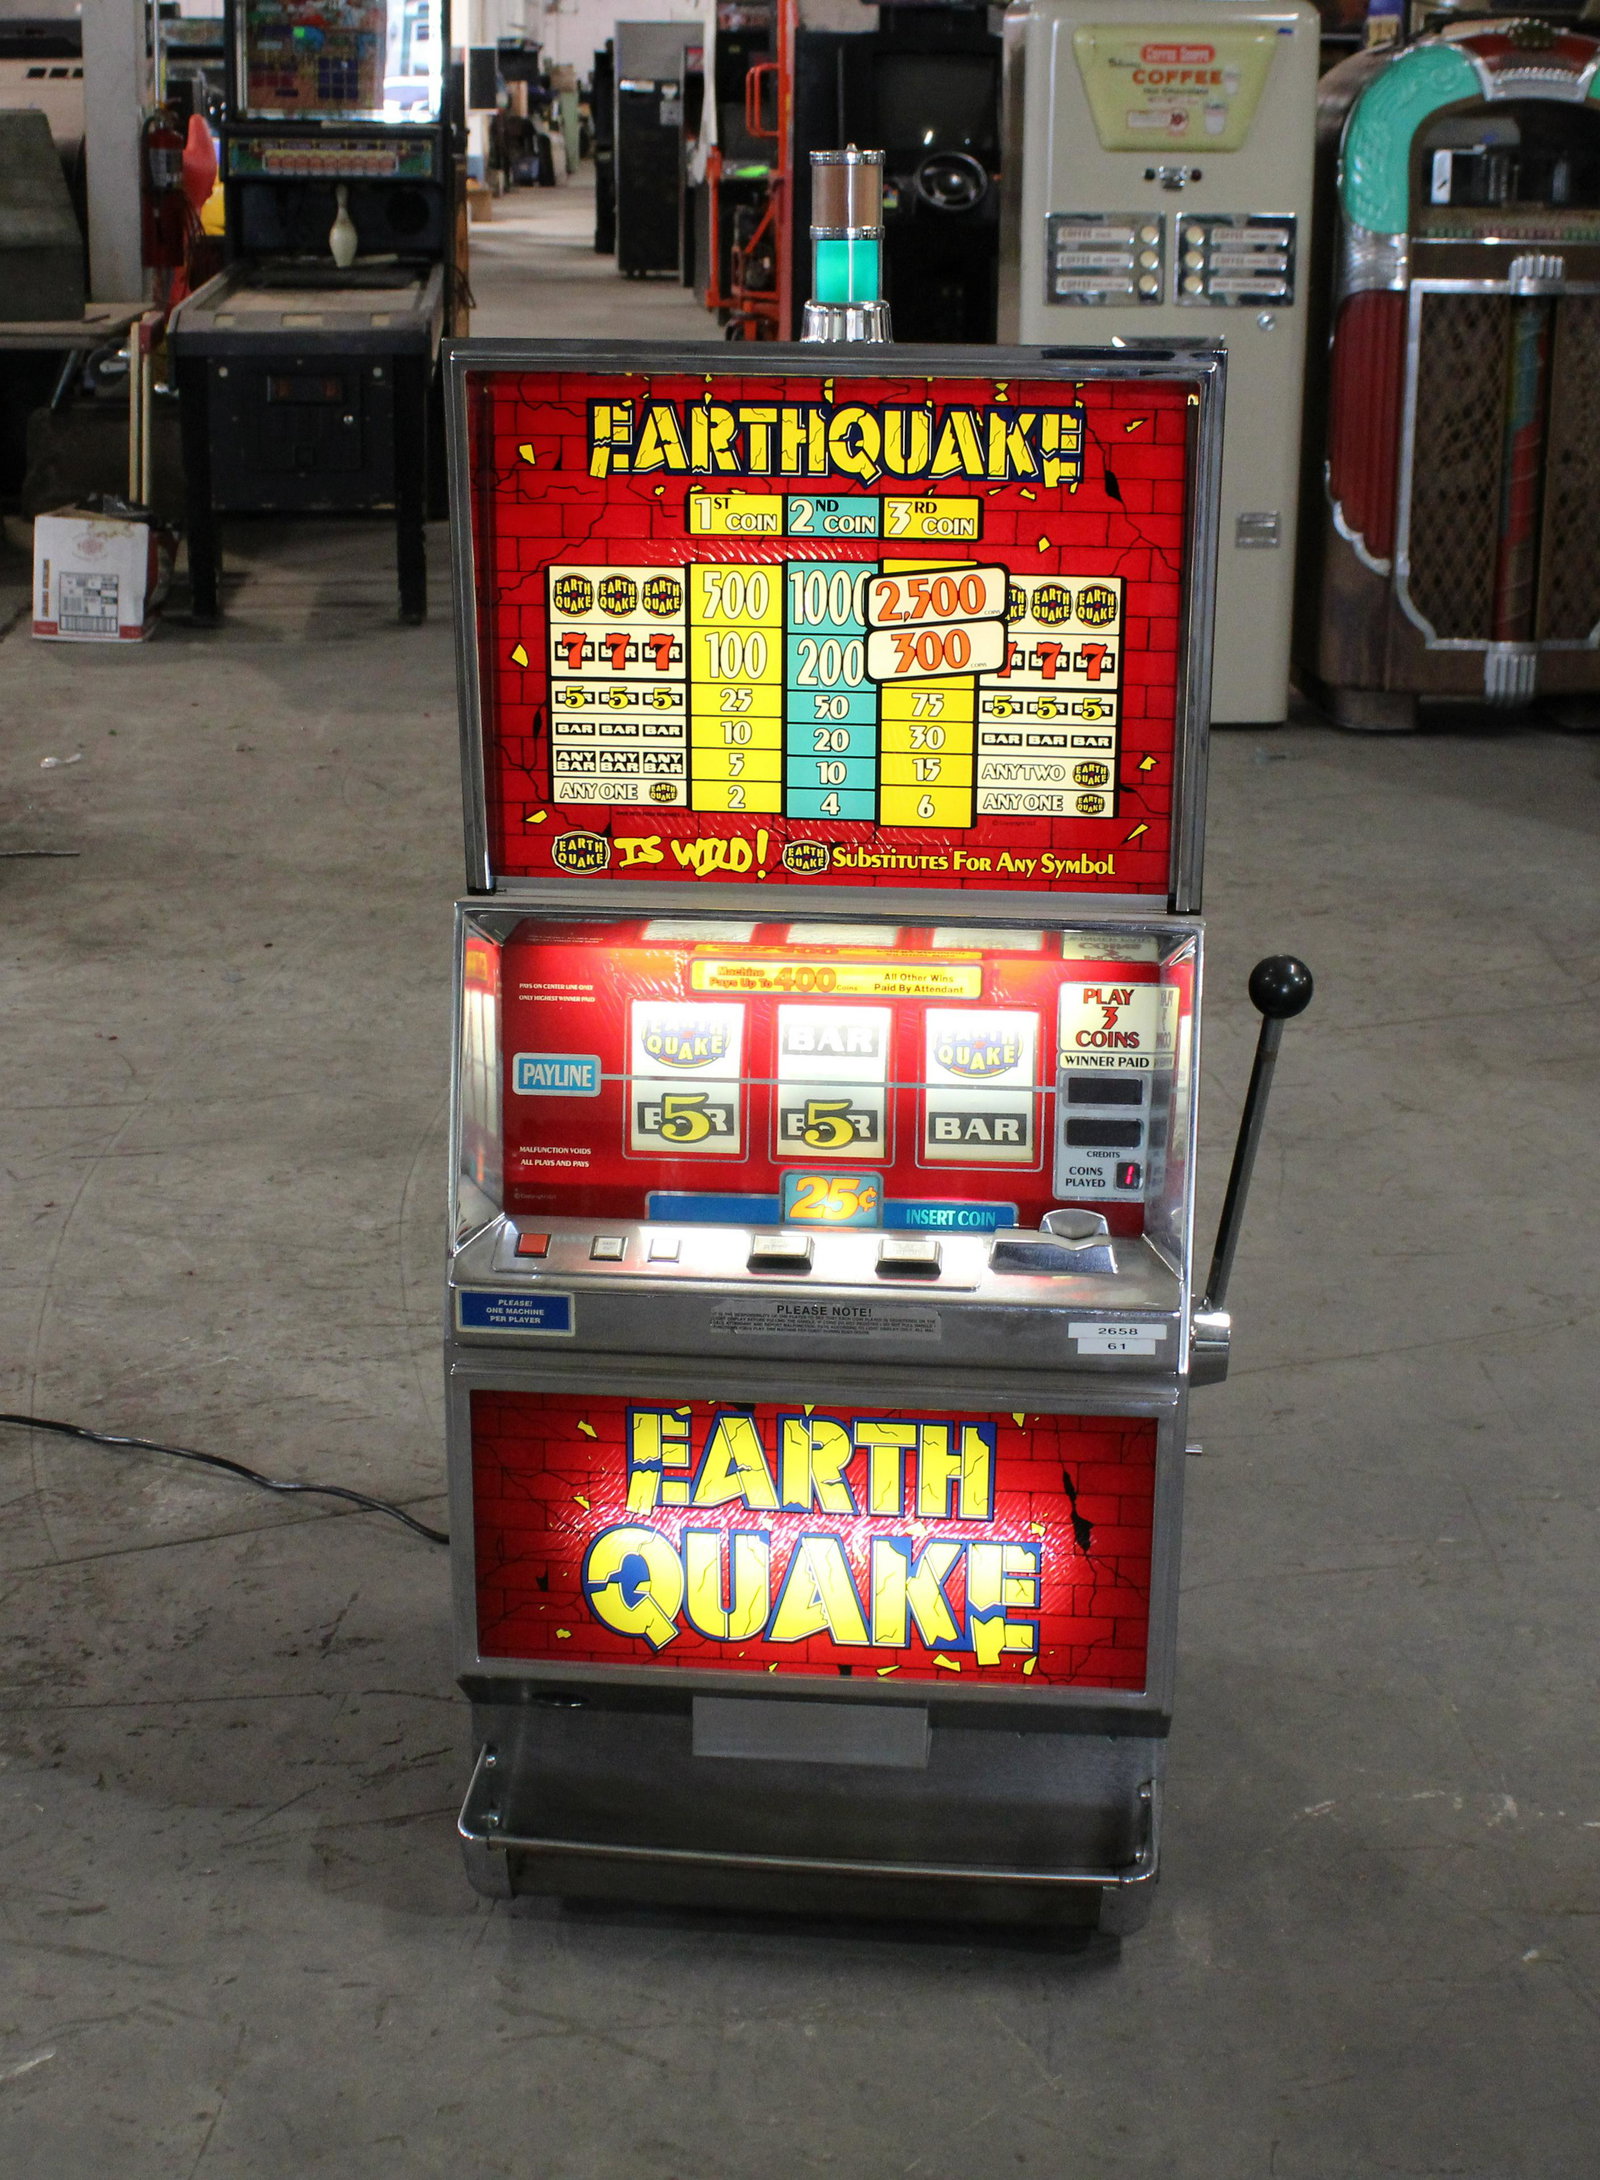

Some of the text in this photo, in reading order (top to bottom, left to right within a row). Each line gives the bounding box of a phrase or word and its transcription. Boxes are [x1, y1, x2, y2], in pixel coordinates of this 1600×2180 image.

[1132, 69, 1223, 85] COFFEE
[589, 402, 1083, 488] EARTHQUAKE
[725, 513, 777, 532] COIN
[822, 515, 876, 534] COIN
[921, 517, 975, 536] COIN
[556, 579, 591, 595] EARTH
[601, 580, 635, 596] EARTH
[644, 580, 680, 596] EARTH
[703, 570, 770, 620] 500
[555, 595, 591, 612] QUAKE
[600, 596, 635, 613] QUAKE
[644, 597, 680, 613] QUAKE
[789, 569, 872, 627] 1000
[875, 573, 987, 622] 2,500
[1034, 588, 1070, 605] EARTH
[1079, 589, 1115, 606] EARTH
[1033, 605, 1070, 622] QUAKE
[1077, 606, 1115, 623] QUAKE
[705, 631, 768, 679] 100
[891, 628, 972, 673] 300
[796, 638, 865, 688] 200
[720, 688, 753, 712] 25
[814, 695, 850, 719] 50
[911, 693, 945, 717] 75
[557, 724, 681, 736] BAR BAR BAR
[720, 720, 752, 745] 10
[909, 725, 946, 750] 30
[813, 728, 850, 752] 20
[984, 734, 1110, 747] BAR BAR BAR
[557, 751, 682, 763] ANY ANY ANY
[728, 753, 744, 776] 5
[557, 761, 682, 773] BAR BAR BAR
[816, 761, 847, 785] 10
[912, 757, 942, 781] 15
[981, 763, 1066, 781] ANY TWO
[1076, 764, 1107, 774] EARTH
[1074, 774, 1108, 785] QUAKE
[560, 782, 638, 800] ANY ONE
[728, 785, 746, 808] 2
[820, 792, 841, 815] 4
[917, 794, 935, 818] 6
[983, 793, 1064, 811] ANY ONE
[559, 840, 603, 853] EARTH
[613, 828, 769, 879] IS WILD!
[788, 844, 824, 857] EARTH
[557, 853, 604, 868] QUAKE
[787, 856, 824, 870] QUAKE
[709, 966, 858, 993] Pays Up To 400 Coins
[717, 966, 765, 978] Machine
[884, 972, 954, 983] All Other Wins
[874, 983, 964, 994] Paid By Attendant
[1083, 988, 1135, 1005] PLAY
[1101, 1006, 1119, 1029] 3
[646, 1034, 724, 1060] QUAKE
[788, 1025, 873, 1053] BAR
[1075, 1030, 1140, 1049] COINS
[938, 1045, 1015, 1070] QUAKE
[1064, 1055, 1149, 1068] WINNER PAID
[523, 1063, 592, 1087] PAYLINE
[934, 1117, 1019, 1141] BAR
[519, 1146, 591, 1155] MALFUNCTION VOIDS
[572, 1160, 590, 1168] PAYS
[1069, 1166, 1103, 1176] COINS
[1065, 1178, 1106, 1188] PLAYED
[789, 1176, 877, 1221] 25¢
[906, 1209, 996, 1227] INSERT COIN
[498, 1299, 533, 1307] PLEASE!
[777, 1304, 827, 1316] PLEASE
[832, 1306, 872, 1318] NOTE!
[508, 1316, 541, 1324] PLAYER
[1098, 1327, 1138, 1335] 2658
[1107, 1342, 1126, 1350] 61
[626, 1405, 997, 1522] EARTH
[581, 1523, 1042, 1667] QUAKE
